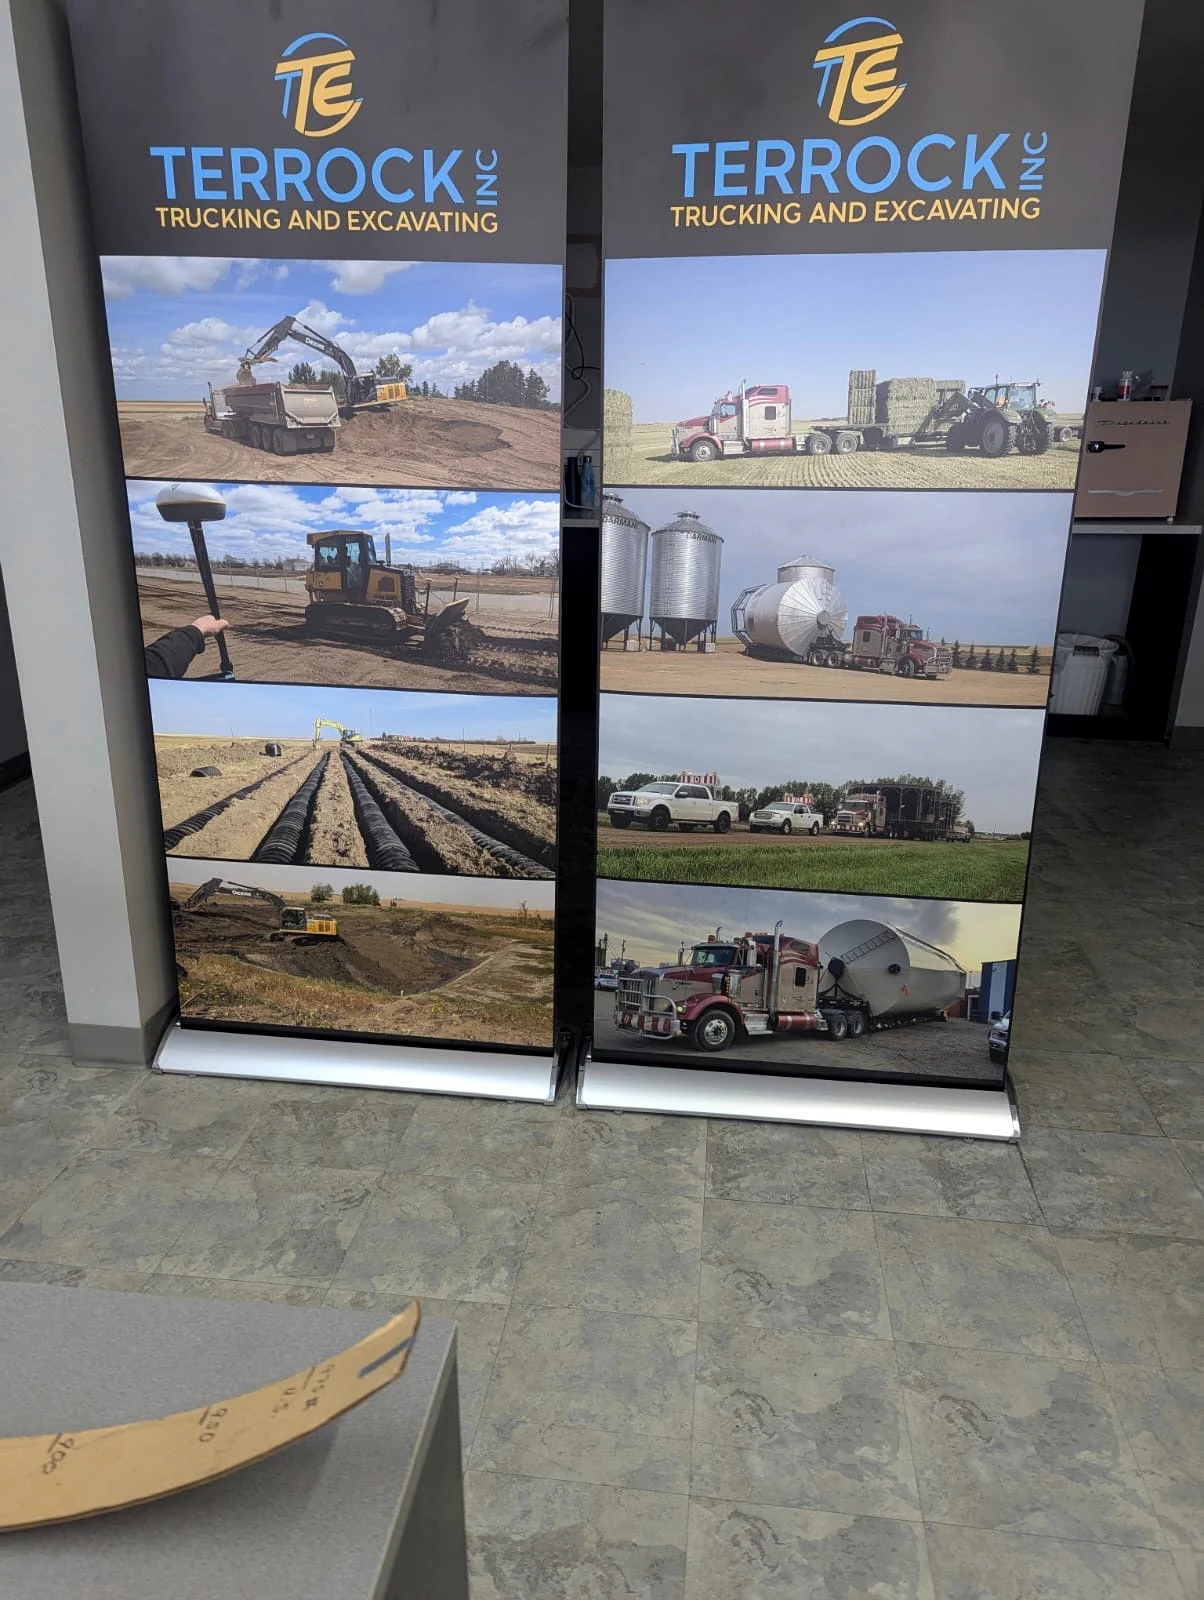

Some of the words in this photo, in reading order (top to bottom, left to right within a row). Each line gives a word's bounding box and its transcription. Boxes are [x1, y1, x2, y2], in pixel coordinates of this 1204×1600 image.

[150, 146, 464, 204] TERROCK
[475, 148, 498, 206] INC
[672, 132, 1011, 198] TERROCK
[1018, 131, 1048, 191] INC
[155, 207, 281, 230] TRUCKING
[288, 208, 341, 231] AND
[347, 209, 498, 234] EXCAVATING
[670, 202, 801, 228] TRUCKING
[808, 201, 867, 225] AND
[874, 197, 1041, 223] EXCAVATING
